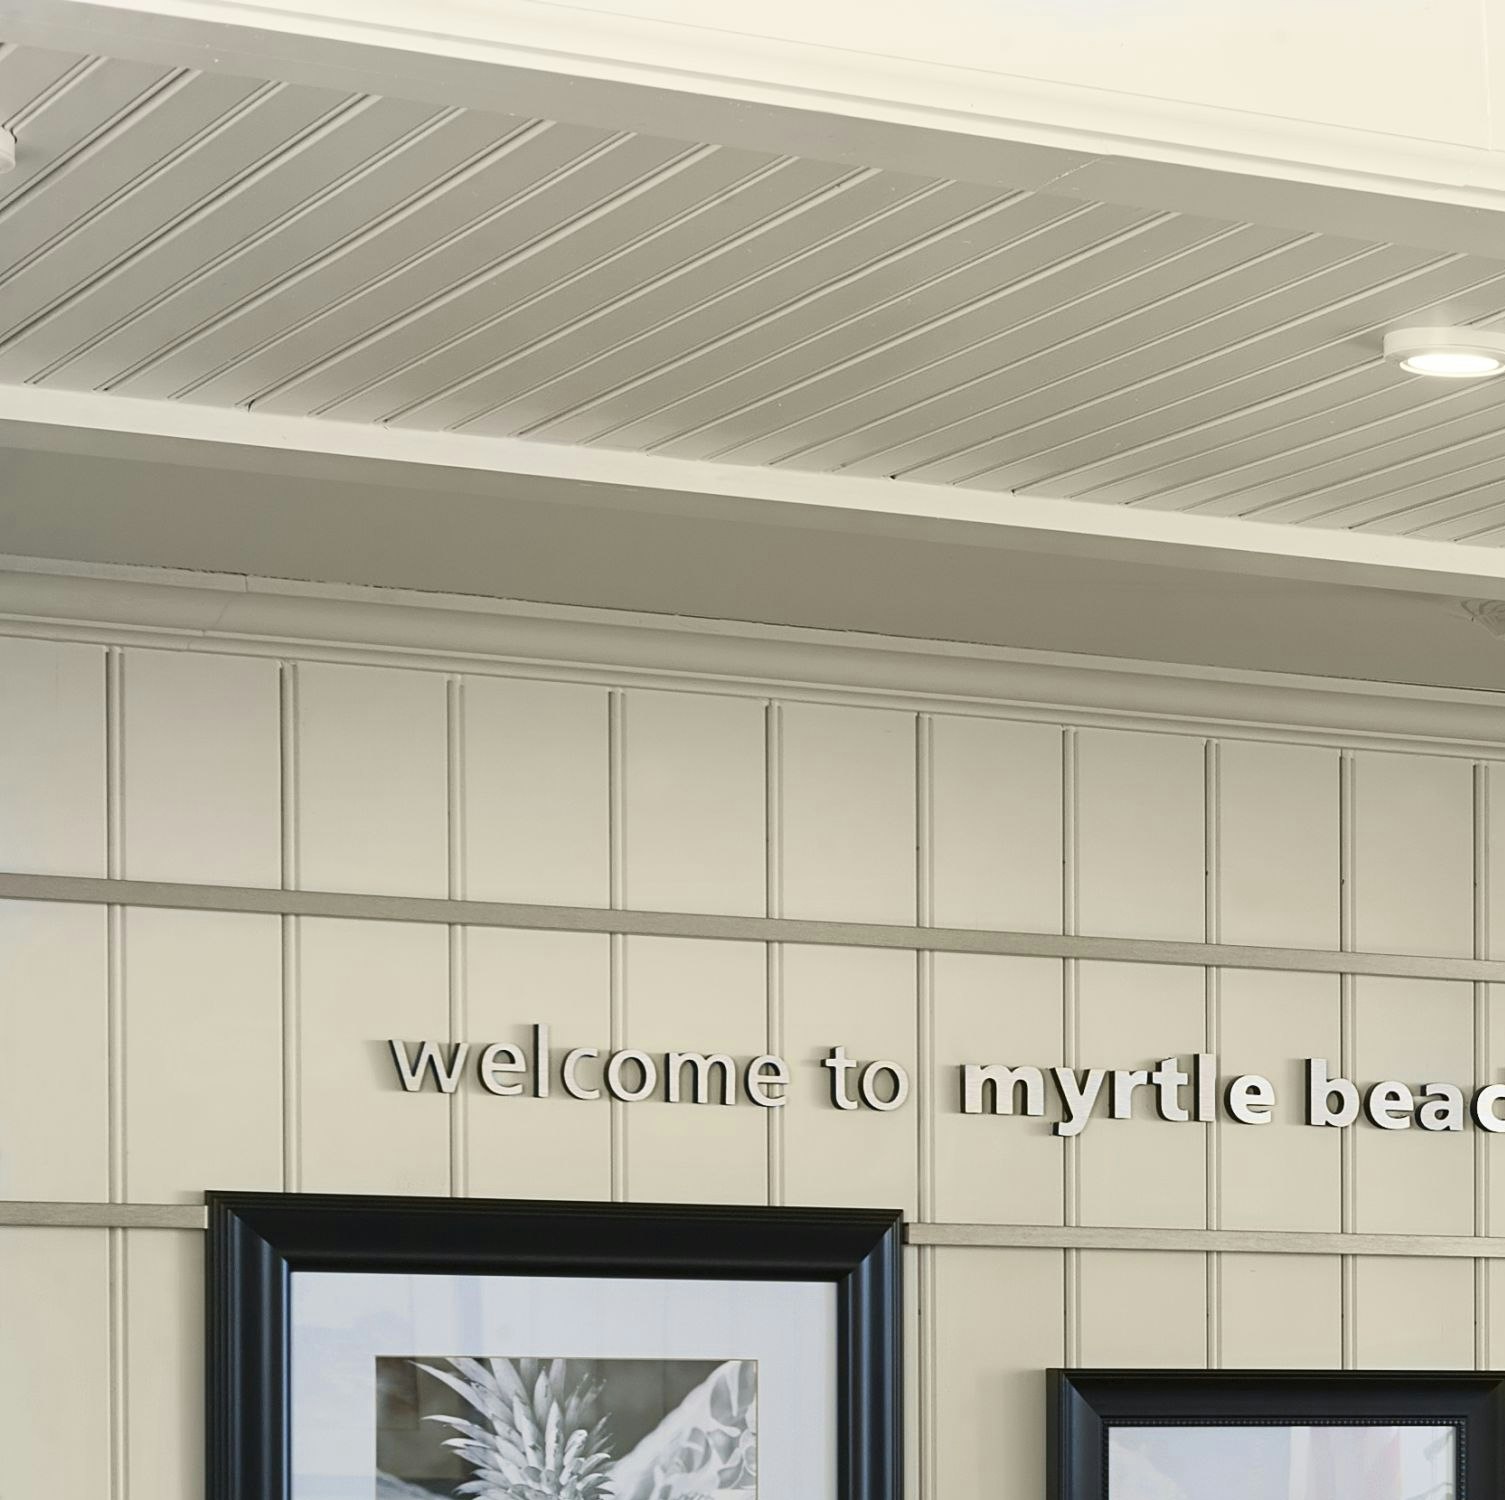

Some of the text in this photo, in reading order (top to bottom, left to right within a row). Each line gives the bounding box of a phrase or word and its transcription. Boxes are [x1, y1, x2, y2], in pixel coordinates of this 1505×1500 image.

[389, 1022, 790, 1108] welcome
[822, 1046, 910, 1111] to
[959, 1053, 1276, 1137] myrtle
